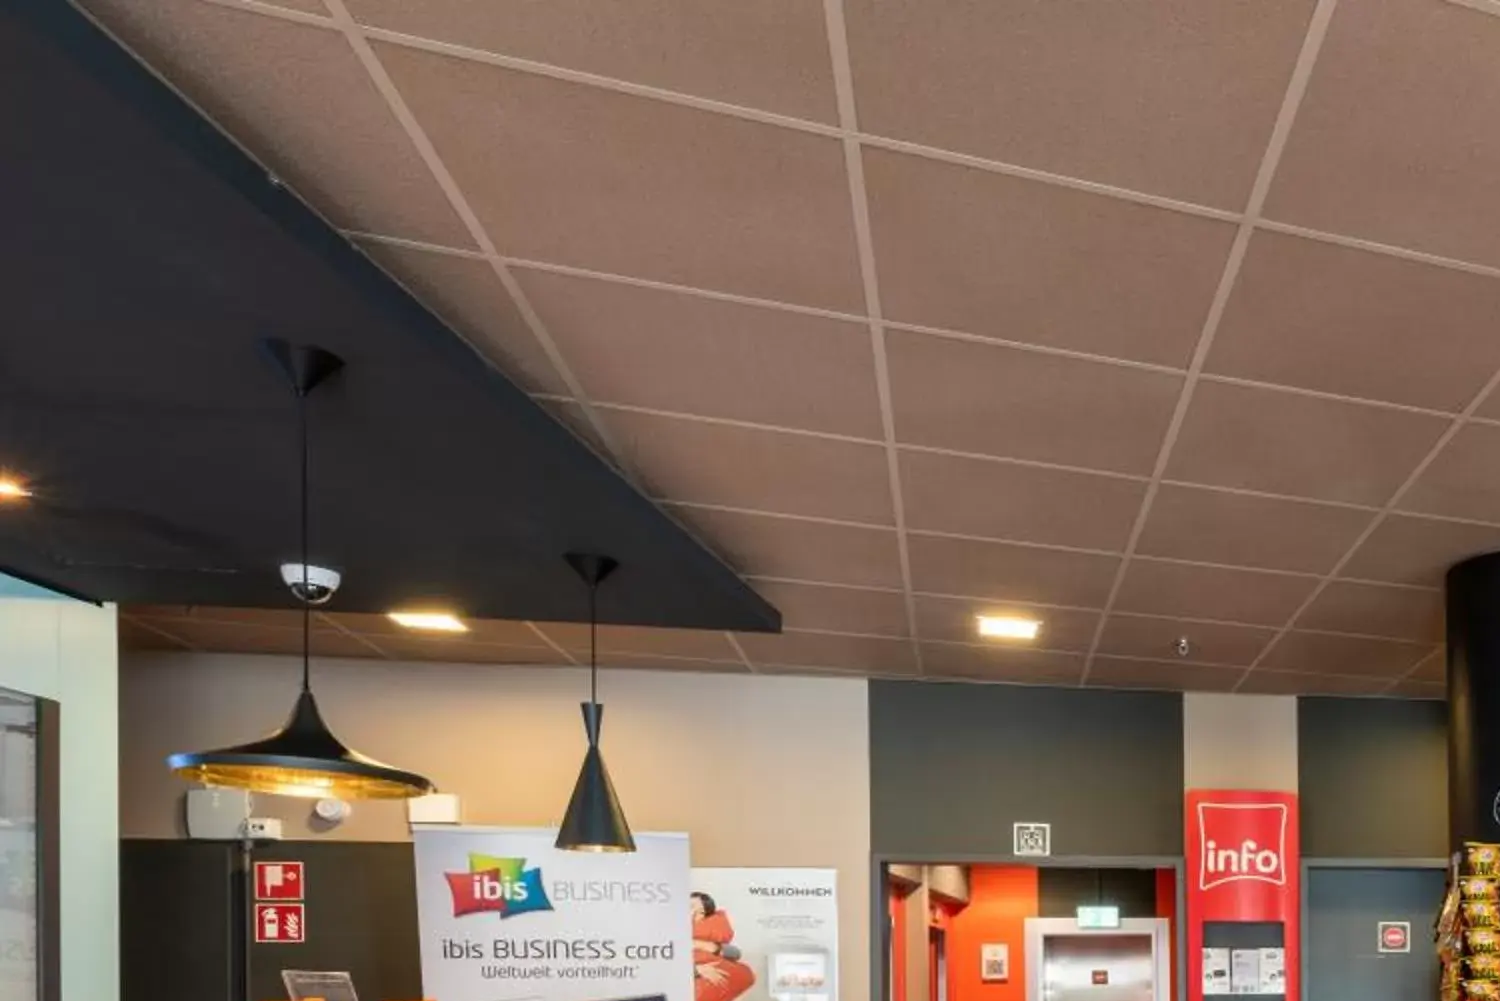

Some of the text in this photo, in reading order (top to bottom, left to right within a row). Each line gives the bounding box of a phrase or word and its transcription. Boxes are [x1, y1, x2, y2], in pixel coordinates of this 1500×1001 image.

[1206, 838, 1279, 874] info
[472, 875, 672, 904] ibis BUSINESS
[749, 886, 832, 897] WILLKOMMEN
[442, 939, 674, 960] ibis BUSINESS card
[481, 965, 551, 979] Weltweit
